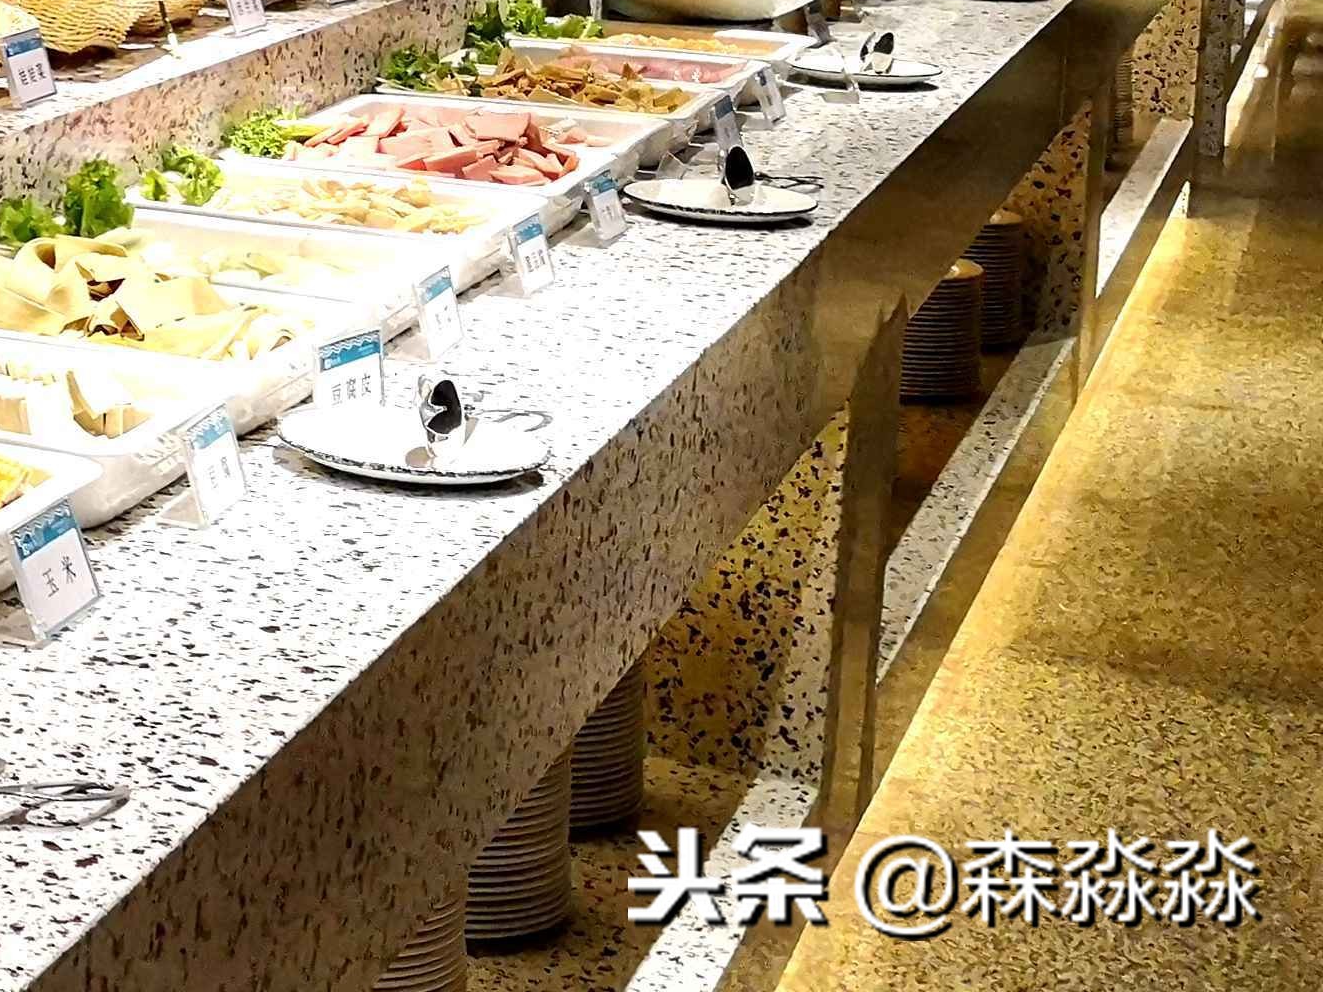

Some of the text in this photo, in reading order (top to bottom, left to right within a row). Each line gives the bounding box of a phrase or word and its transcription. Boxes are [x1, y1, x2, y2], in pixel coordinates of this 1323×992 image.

[330, 372, 372, 406] 豆腐皮
[42, 554, 77, 598] 玉米
